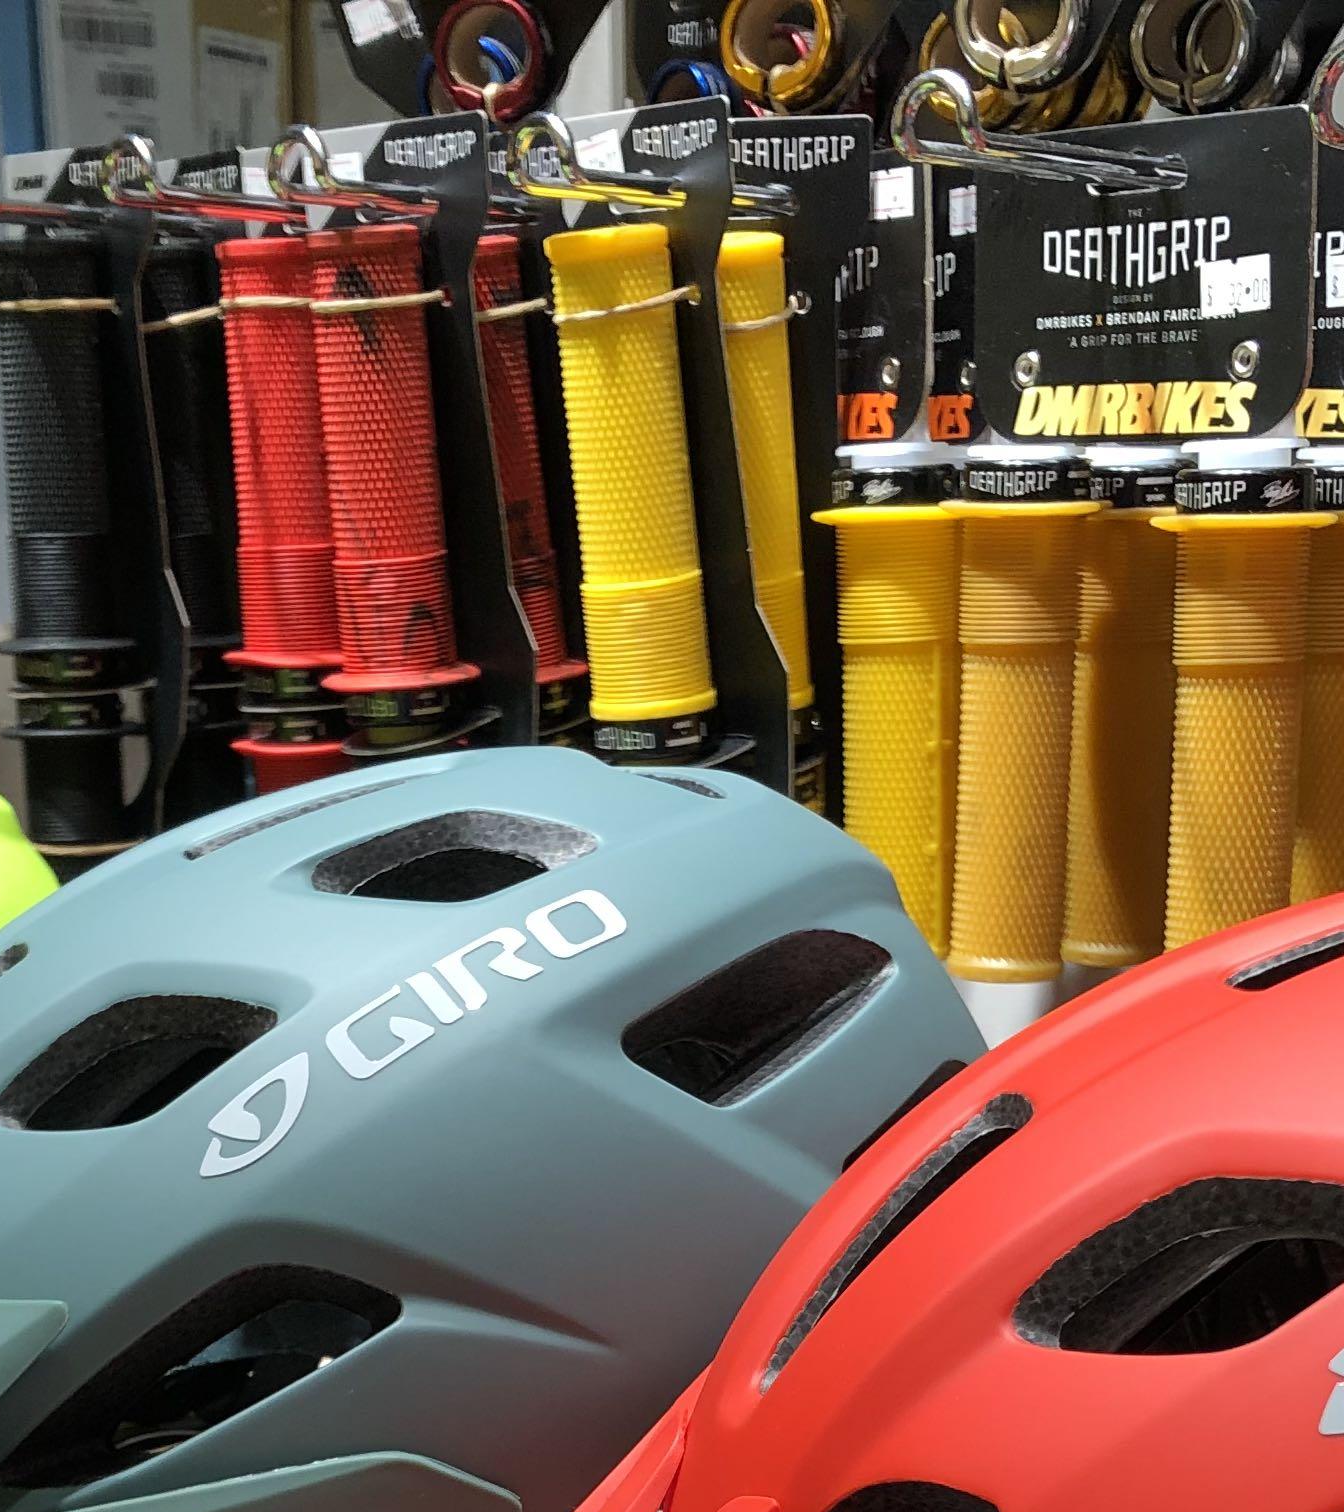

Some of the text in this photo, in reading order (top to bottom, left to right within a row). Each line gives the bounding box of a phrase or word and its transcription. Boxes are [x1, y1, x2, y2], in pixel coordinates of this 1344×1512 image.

[1043, 216, 1231, 288] DEATHGRIP
[1106, 308, 1160, 325] BRENDAN
[1136, 330, 1157, 345] THE
[1014, 380, 1257, 438] DMRBIKES
[970, 470, 1056, 497] DEATHGRIP
[326, 889, 627, 1080] GIRO
